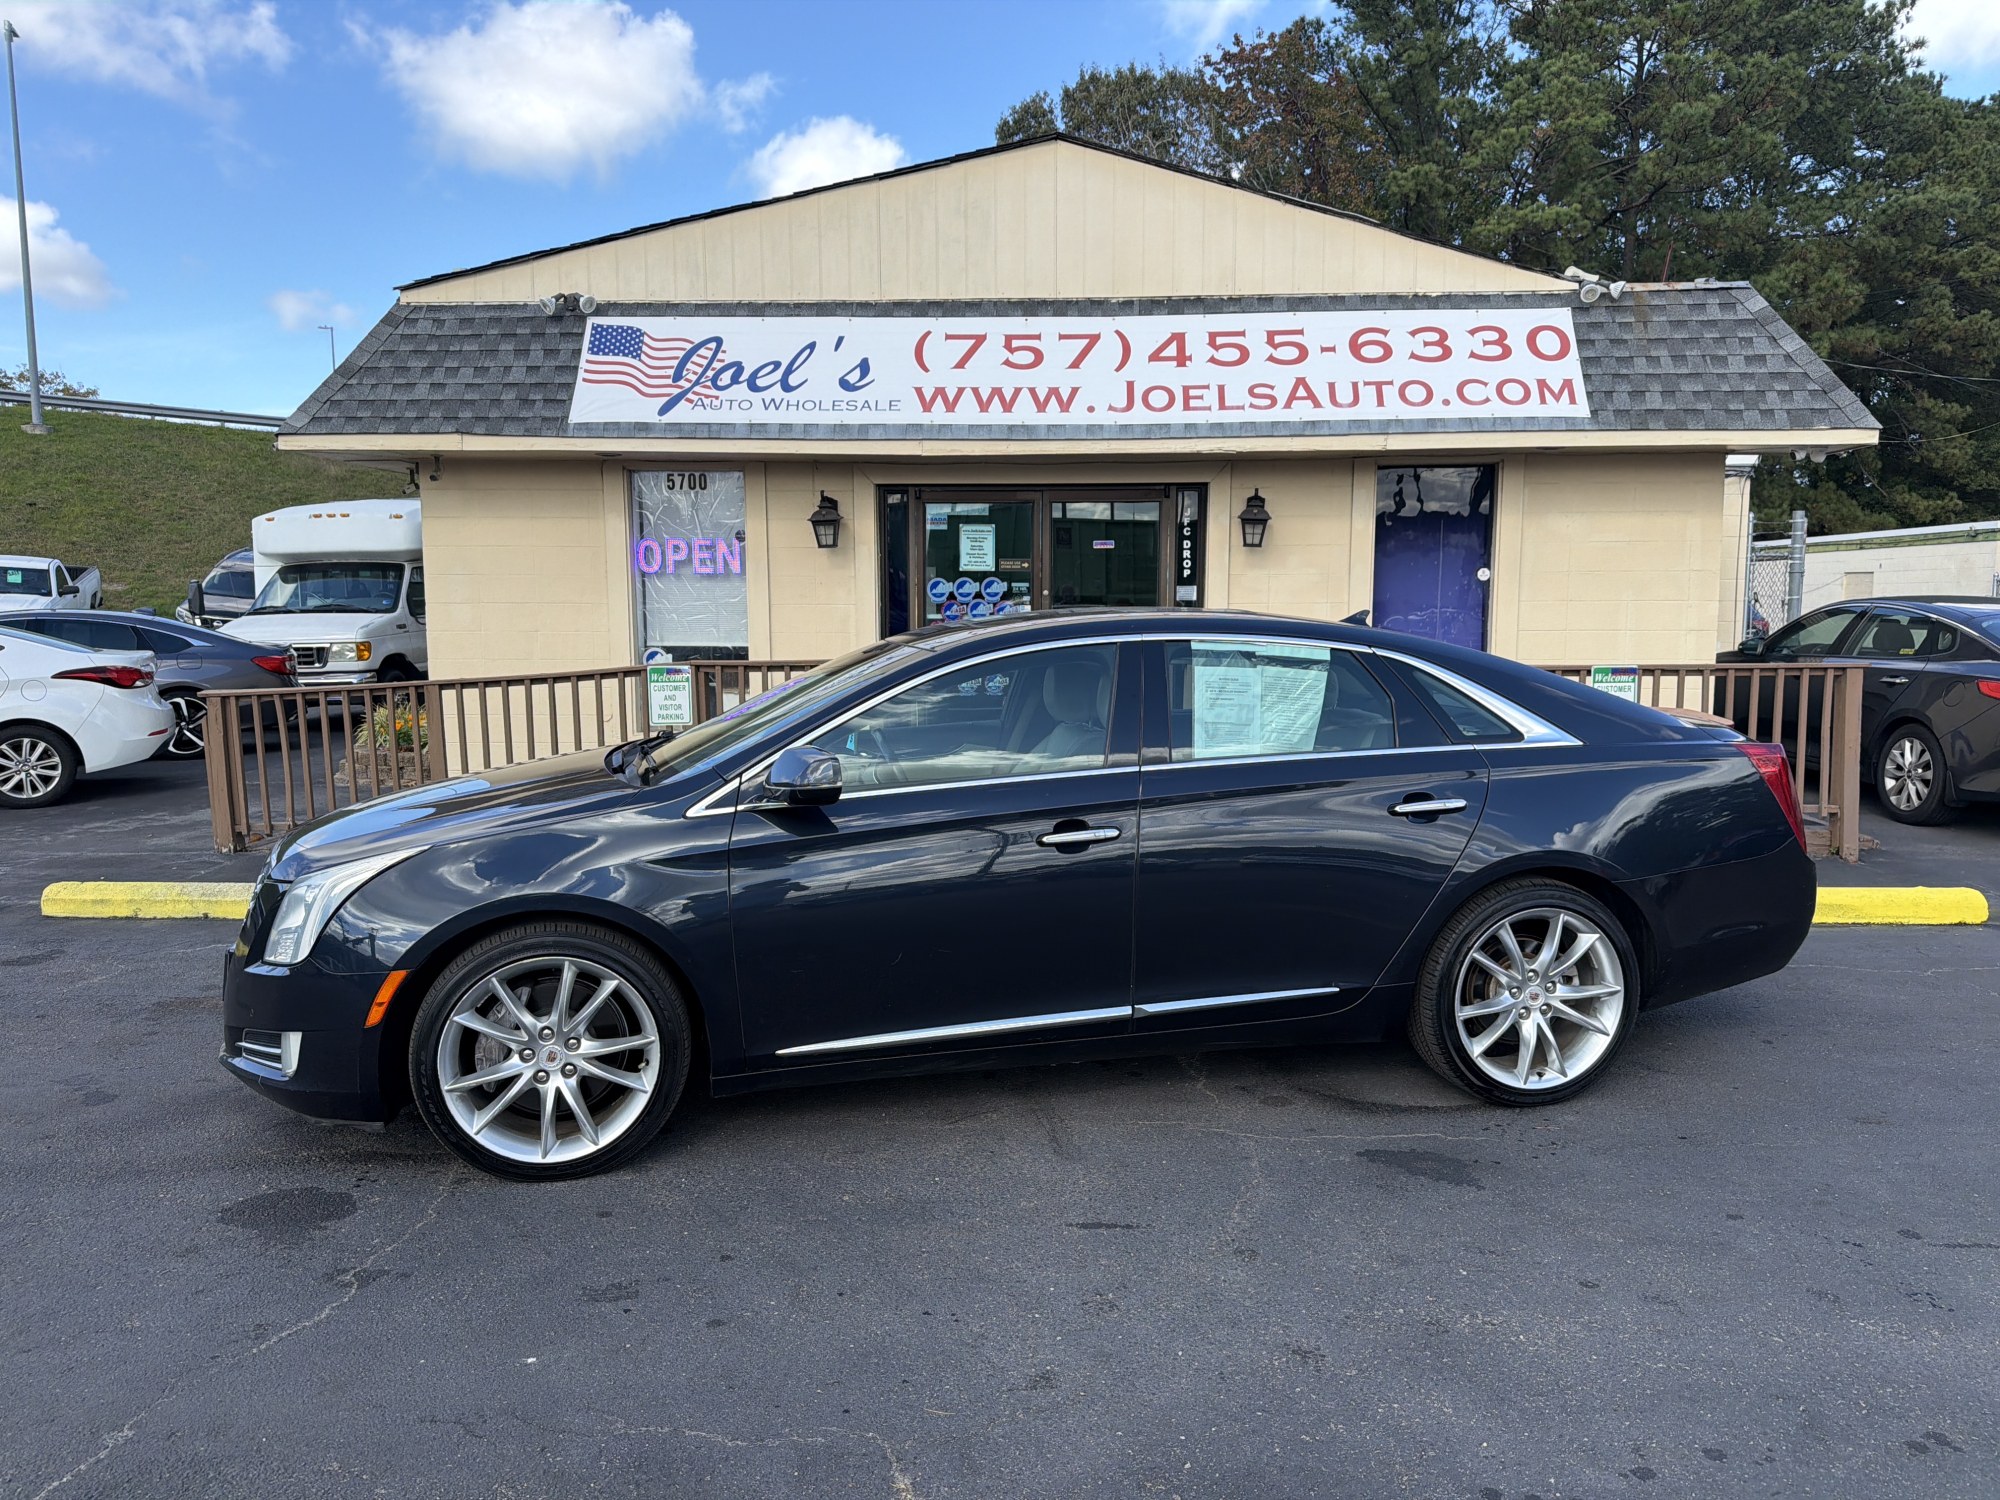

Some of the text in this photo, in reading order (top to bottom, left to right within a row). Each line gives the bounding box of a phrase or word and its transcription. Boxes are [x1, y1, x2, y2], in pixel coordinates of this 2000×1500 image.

[914, 326, 1571, 373] (757)455-6330
[658, 336, 875, 416] Joel's
[761, 398, 901, 412] WHOLESALE
[666, 472, 708, 490] 5700
[636, 537, 742, 575] OPEN
[1183, 540, 1191, 577] DROP
[651, 672, 687, 682] Welcome
[1595, 673, 1635, 682] Welcome
[658, 713, 684, 721] PARKING
